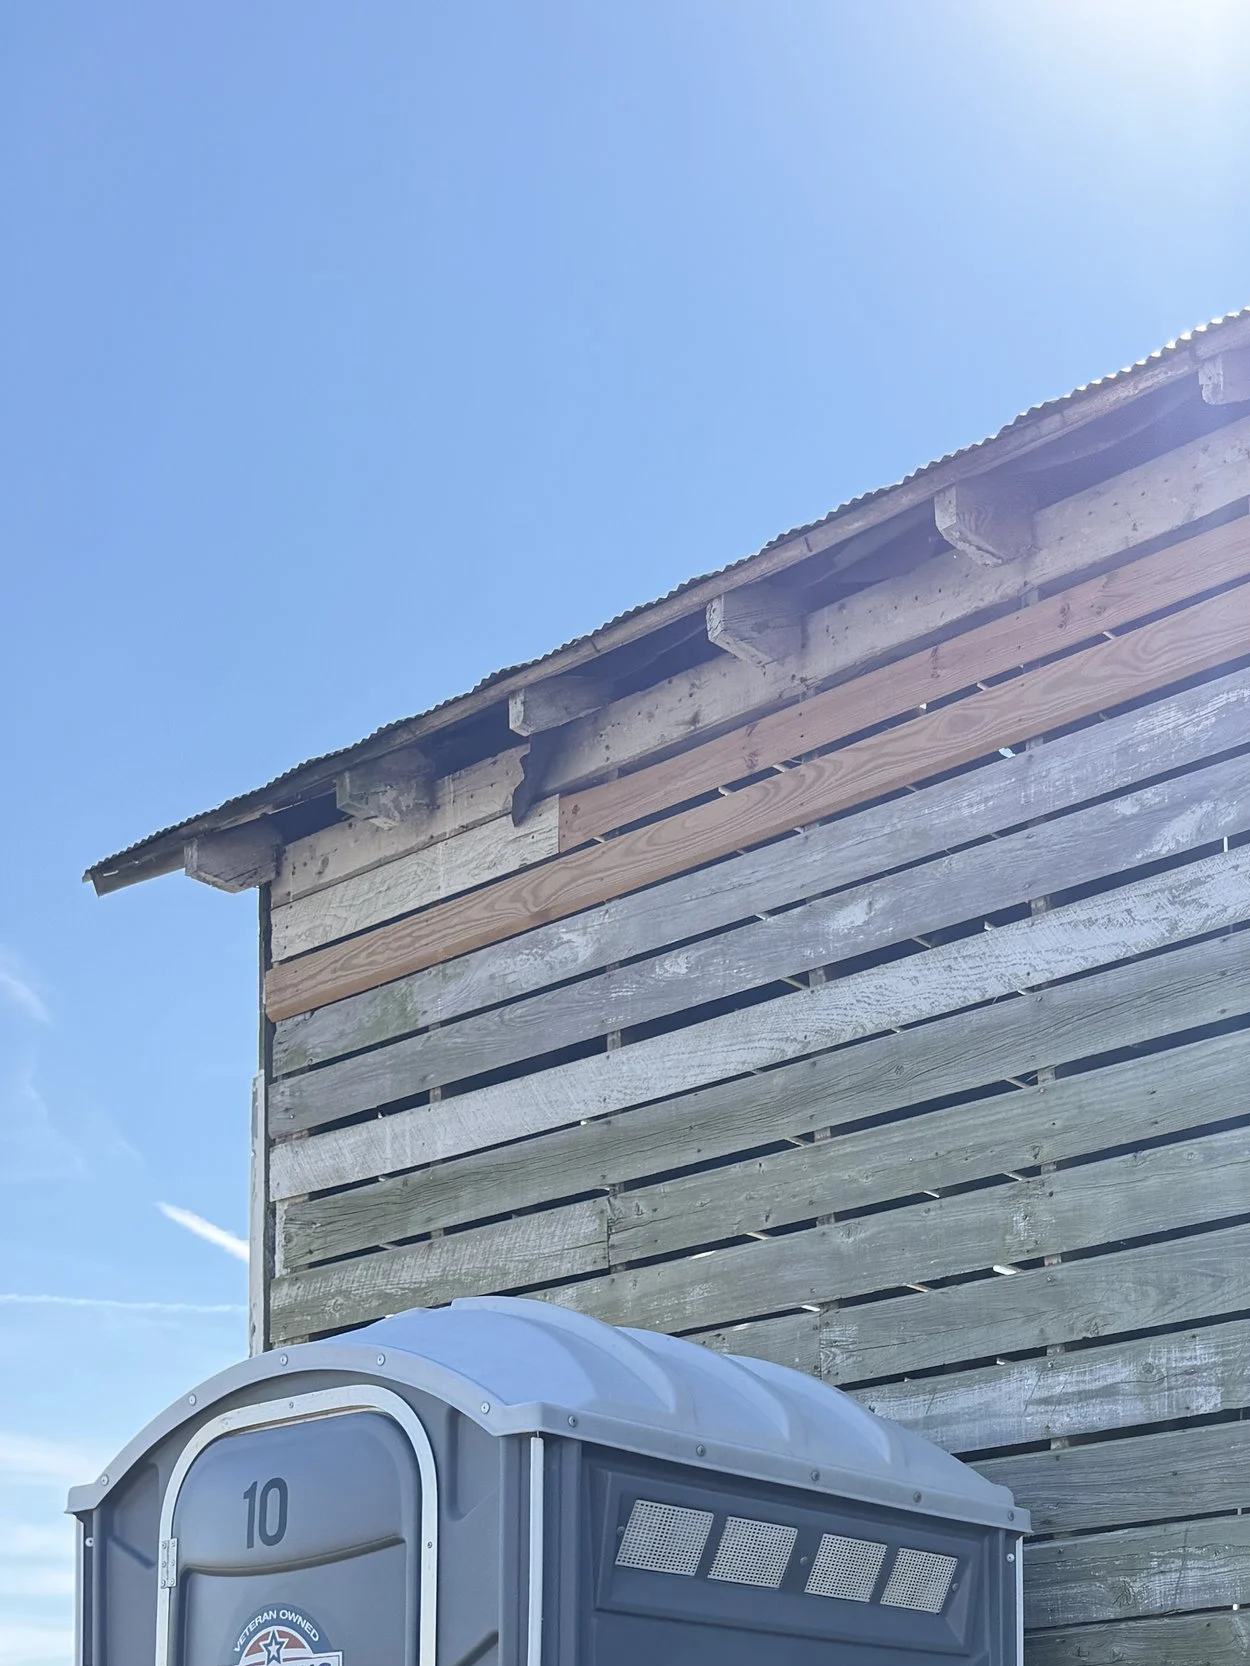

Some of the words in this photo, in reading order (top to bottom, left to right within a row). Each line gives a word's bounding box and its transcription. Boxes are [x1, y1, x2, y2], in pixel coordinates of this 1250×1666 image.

[242, 1477, 289, 1549] 10
[233, 1609, 277, 1654] VETERAN
[279, 1609, 320, 1642] OWNED
